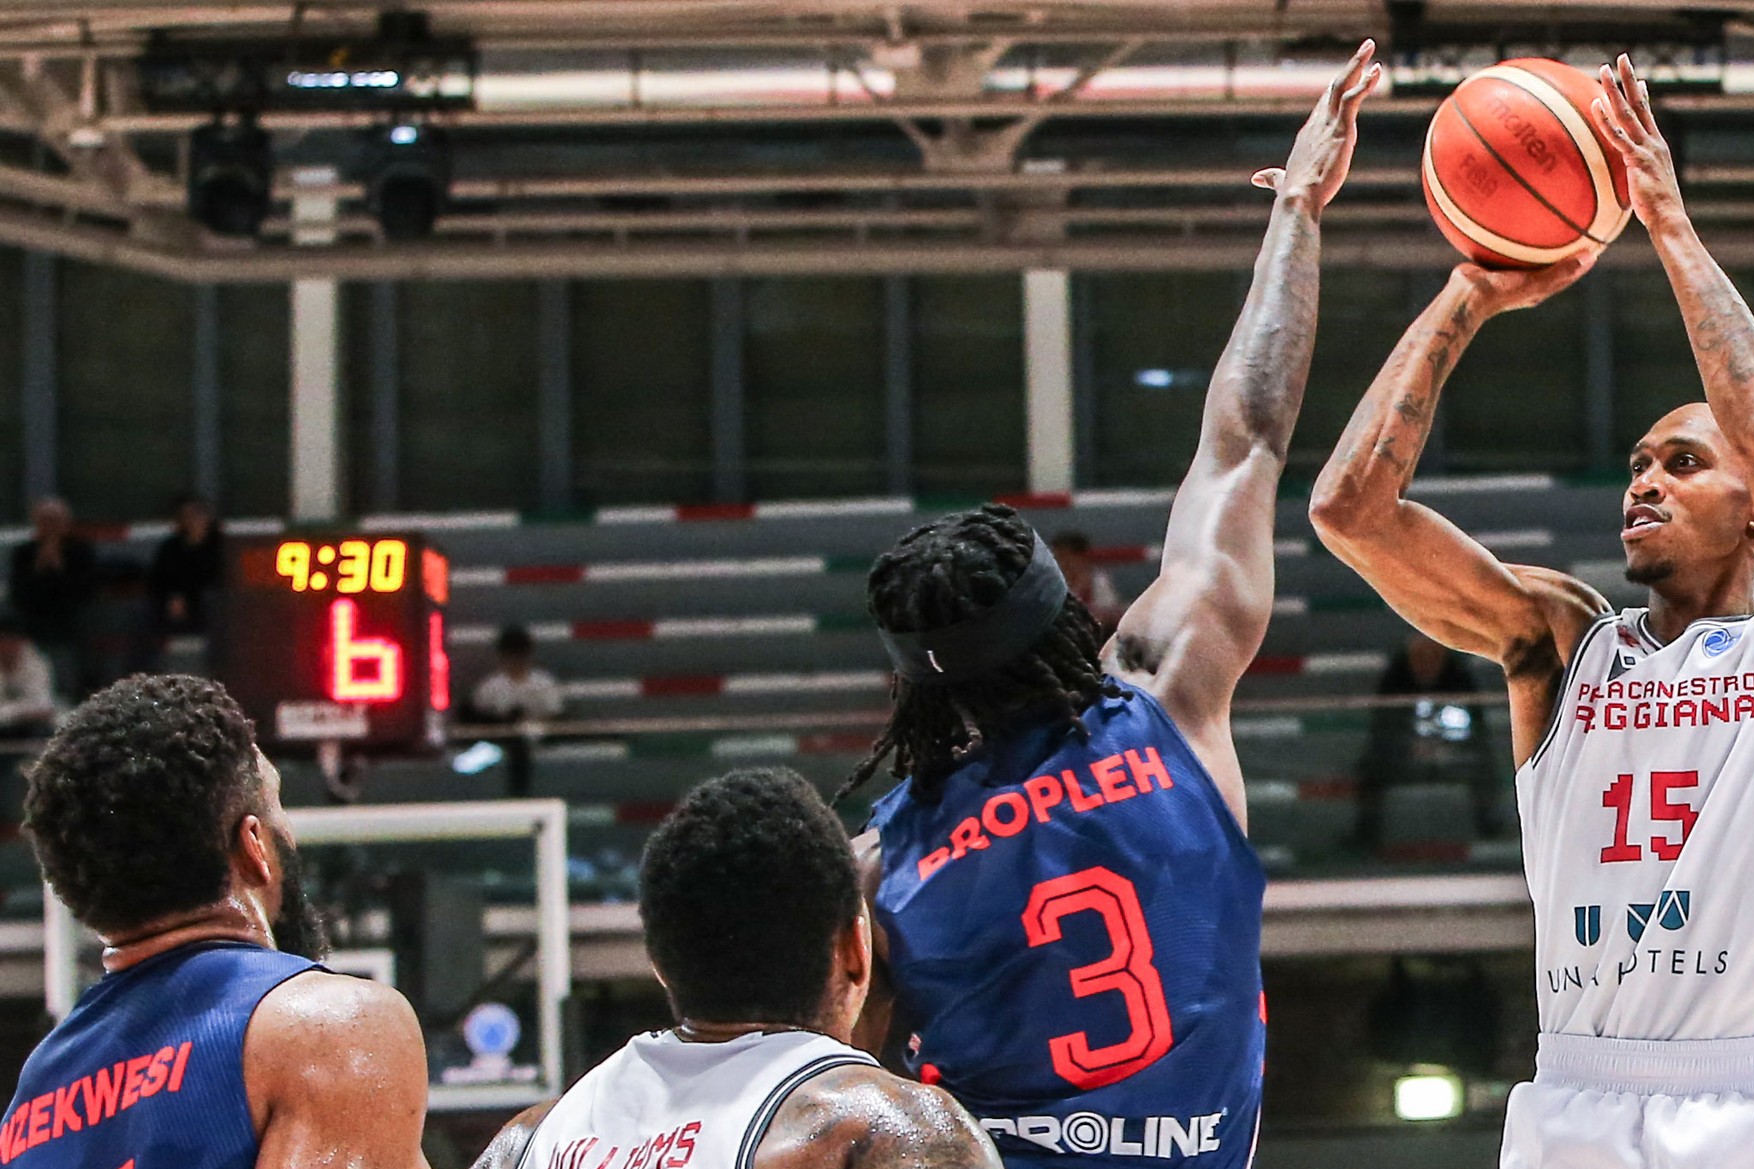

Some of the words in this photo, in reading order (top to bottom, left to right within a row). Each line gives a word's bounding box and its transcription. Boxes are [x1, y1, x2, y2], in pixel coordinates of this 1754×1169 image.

[276, 540, 407, 593] 9:30
[331, 598, 402, 703] 6
[1600, 770, 1700, 864] 15
[1021, 866, 1173, 1091] 3
